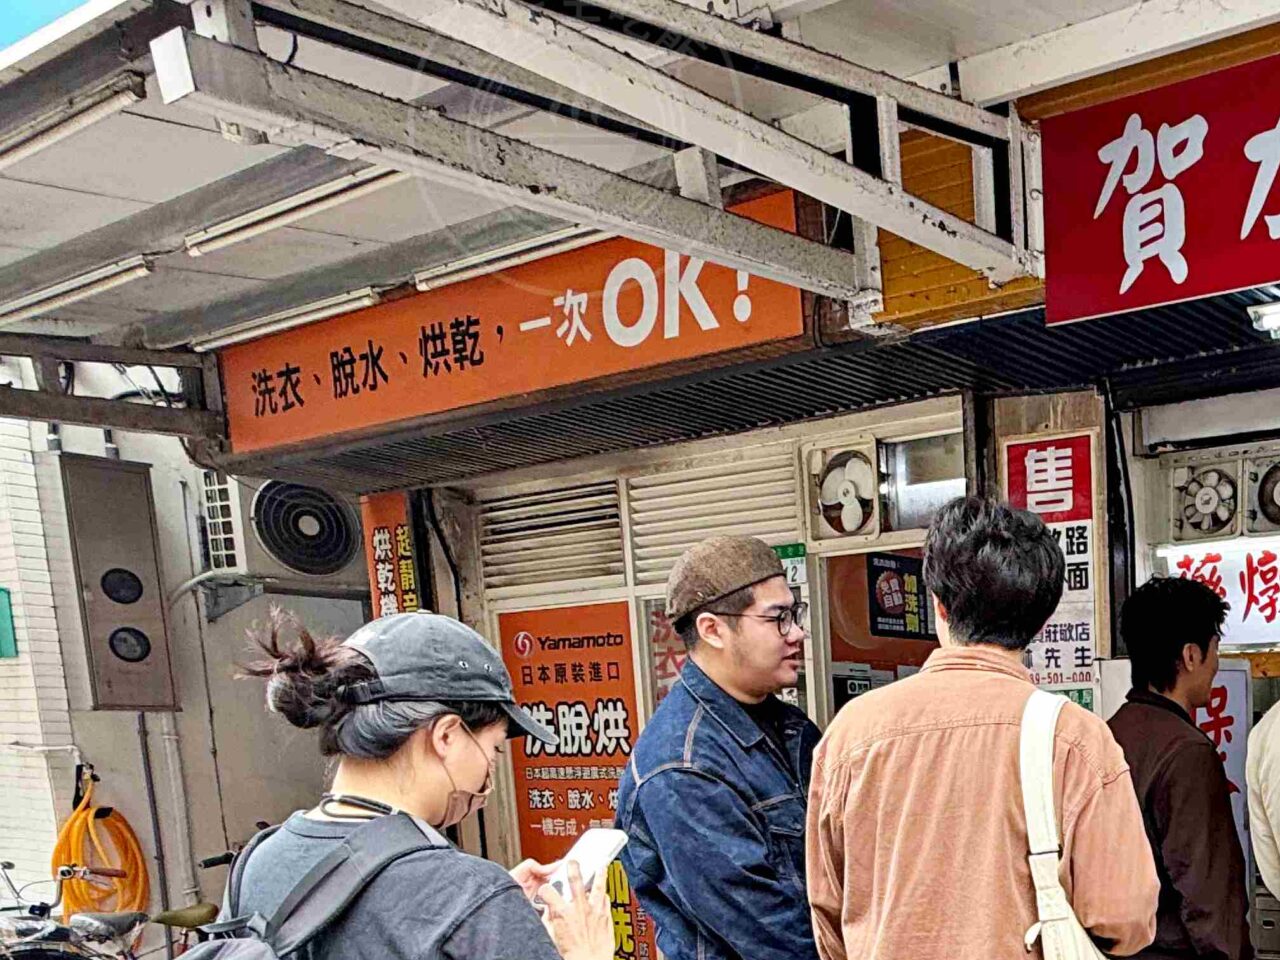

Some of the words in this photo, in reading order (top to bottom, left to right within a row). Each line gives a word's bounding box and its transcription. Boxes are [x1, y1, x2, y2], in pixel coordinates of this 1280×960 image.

[1024, 446, 1073, 514] 售
[537, 631, 624, 652] Yamamoto
[521, 661, 620, 686] 日本原裝進口
